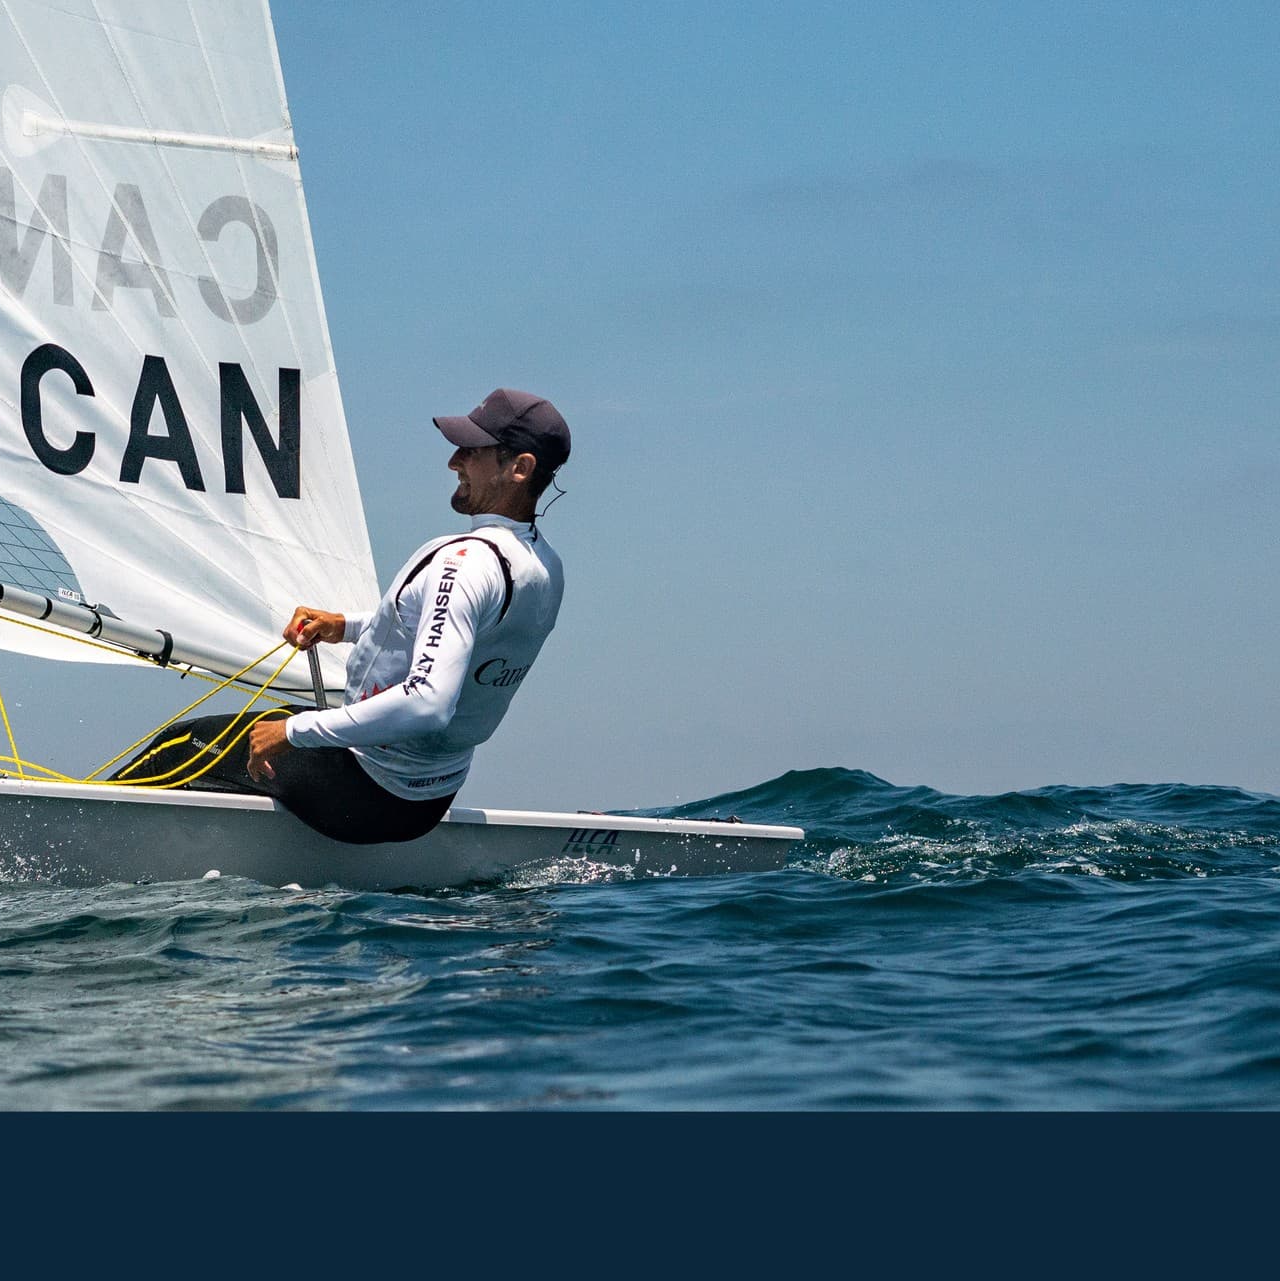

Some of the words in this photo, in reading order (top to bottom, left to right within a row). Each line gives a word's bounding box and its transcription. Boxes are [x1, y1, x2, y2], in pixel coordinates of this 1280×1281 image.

[20, 343, 302, 500] CAN
[426, 567, 458, 648] HANSEN
[561, 829, 620, 854] ILCA
